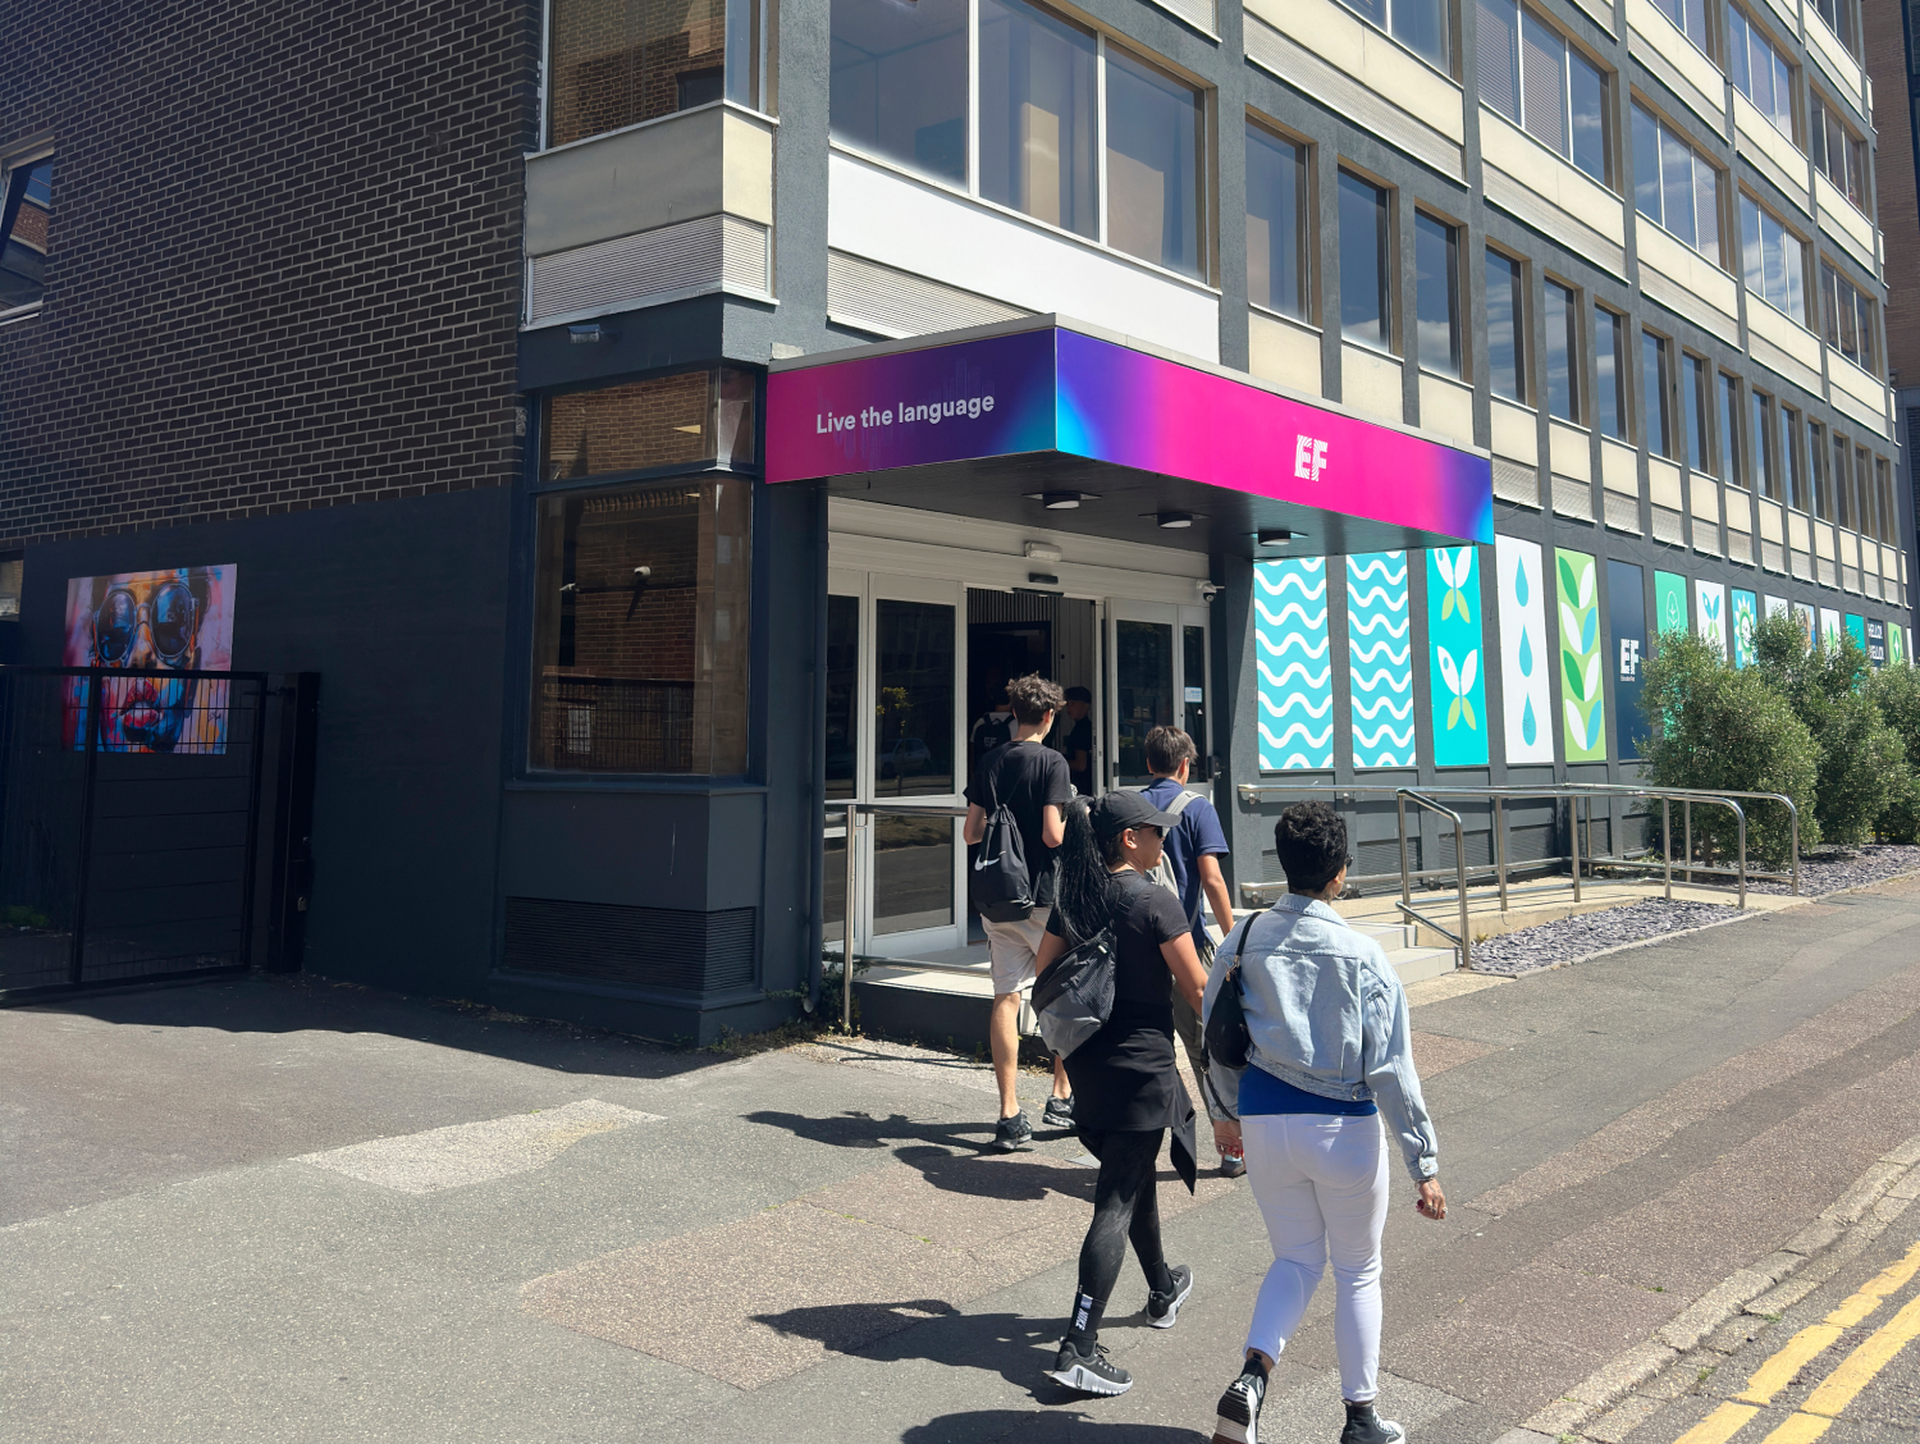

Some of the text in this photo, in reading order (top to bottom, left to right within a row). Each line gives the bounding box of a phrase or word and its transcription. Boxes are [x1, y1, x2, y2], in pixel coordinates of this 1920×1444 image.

[816, 395, 995, 434] Live the language
[1294, 434, 1328, 482] EF
[1620, 638, 1640, 675] EF
[983, 736, 998, 748] EF
[1075, 1307, 1089, 1331] NIKE
